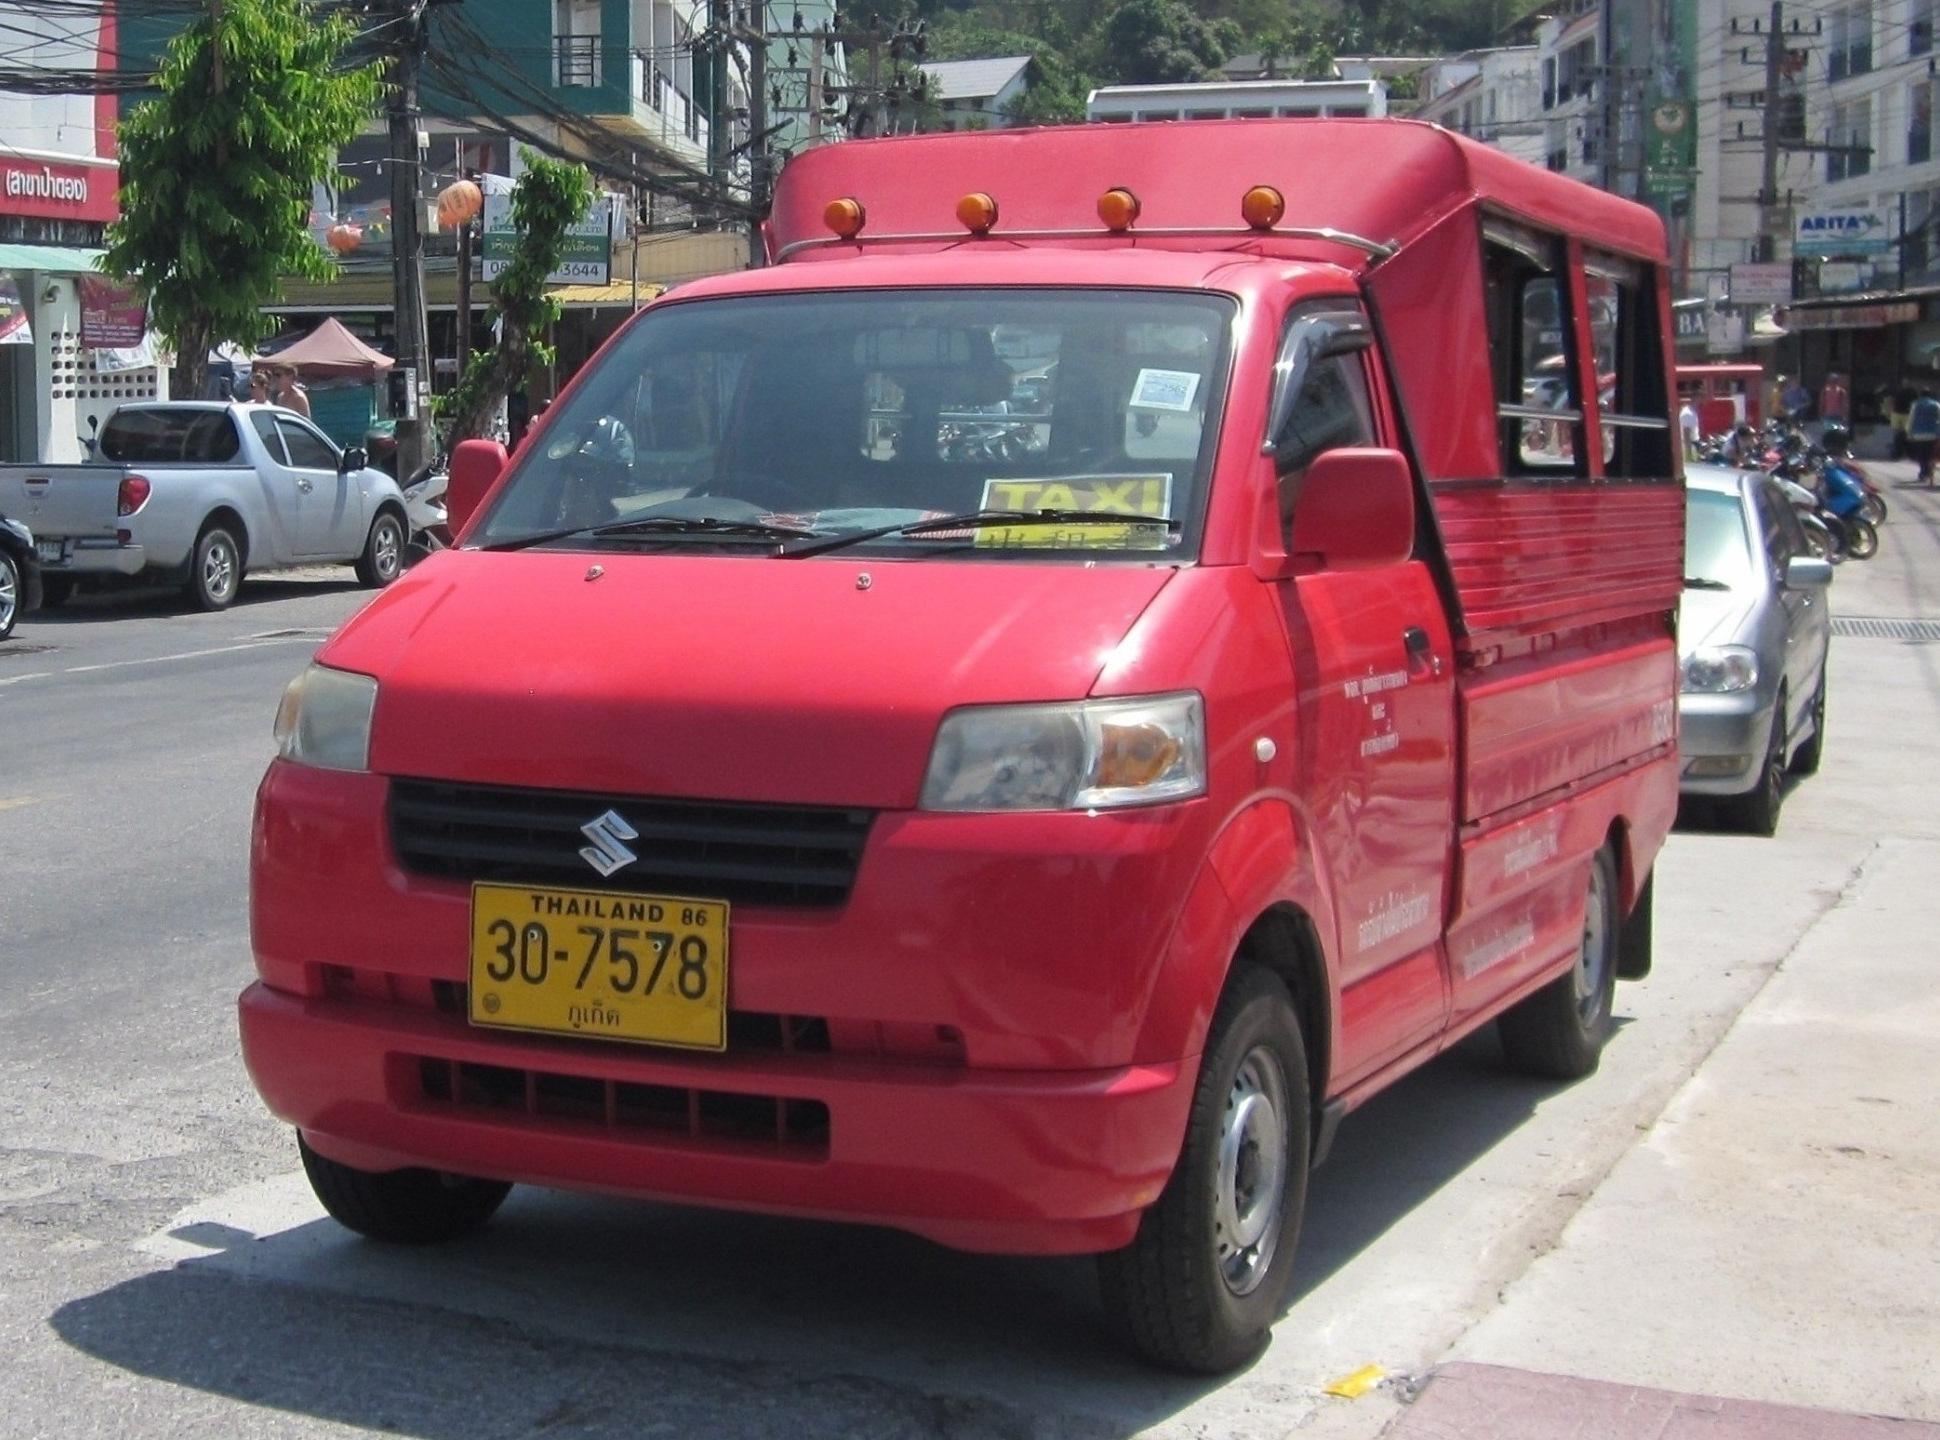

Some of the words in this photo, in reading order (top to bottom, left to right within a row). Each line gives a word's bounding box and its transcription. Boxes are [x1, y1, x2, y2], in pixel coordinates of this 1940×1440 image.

[6, 166, 88, 203] (สาขาป่าตอง)
[1800, 215, 1860, 230] ARITA
[994, 479, 1161, 514] TAXI
[531, 895, 664, 923] THAILAND
[681, 907, 708, 926] 86
[486, 918, 708, 1001] 30-7578
[567, 997, 620, 1029] ภูเก็ต
